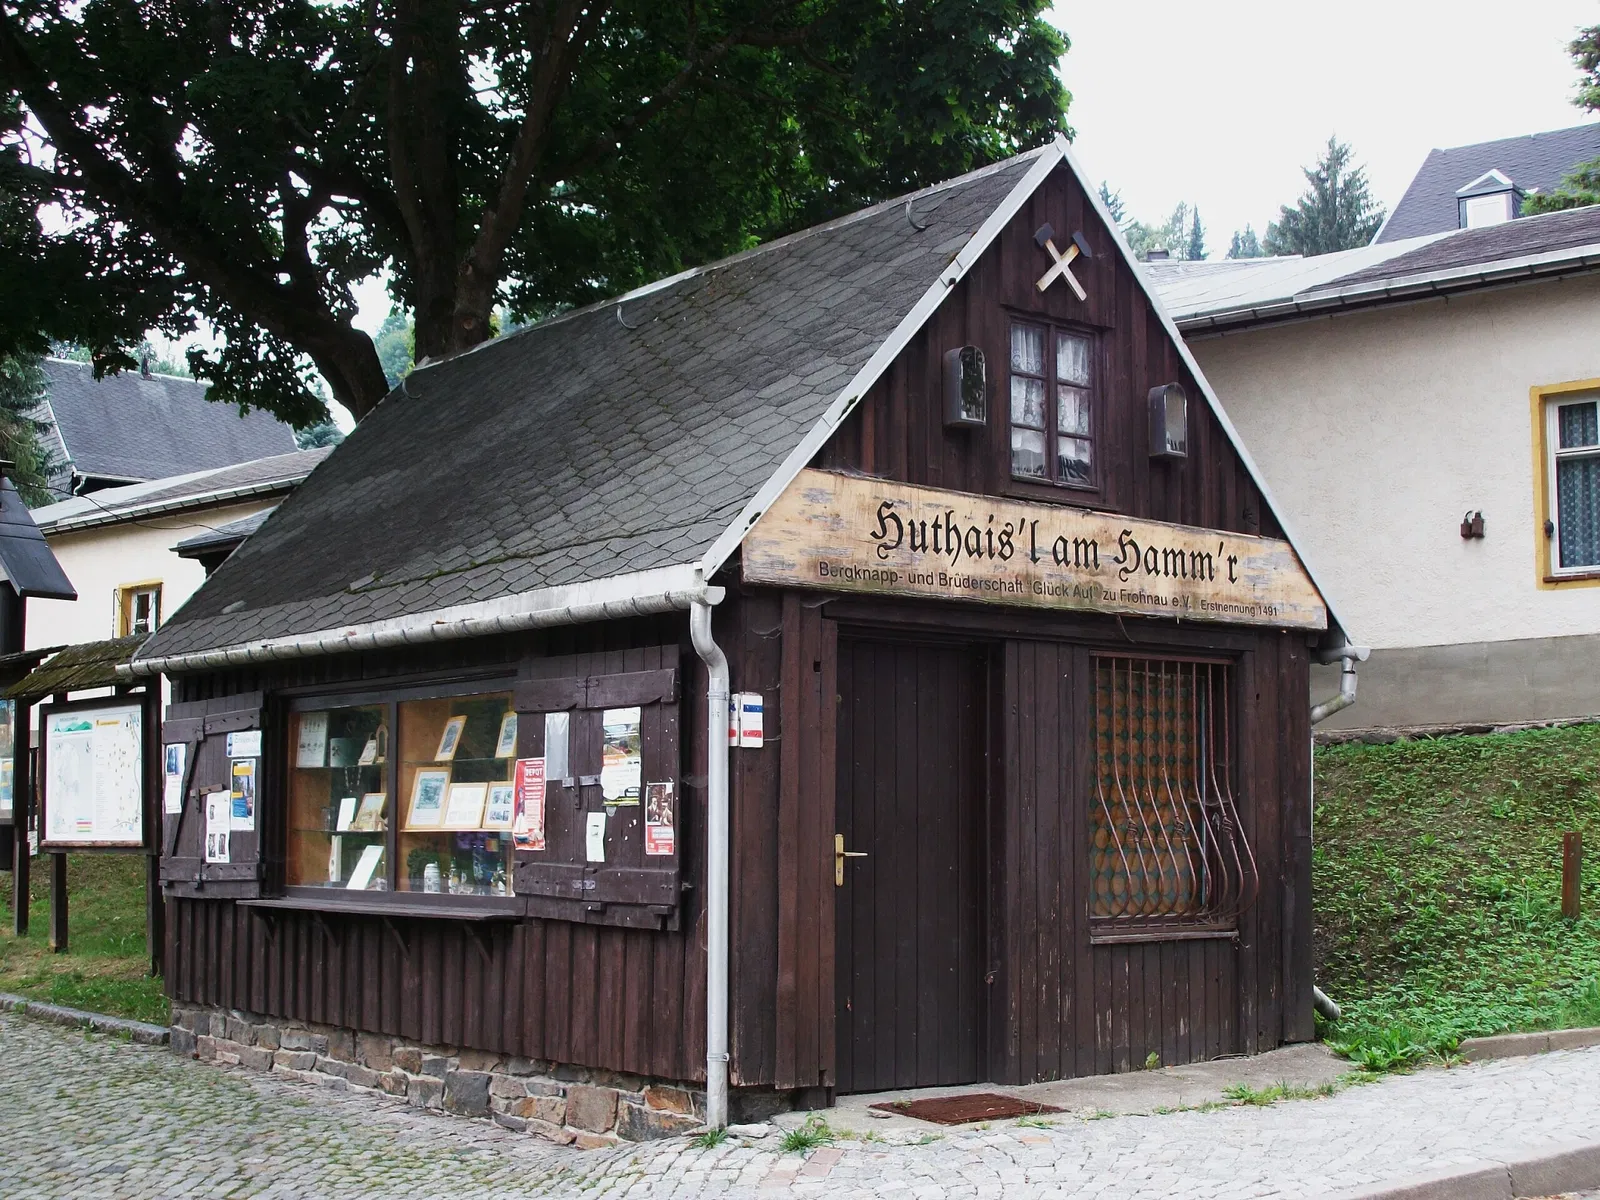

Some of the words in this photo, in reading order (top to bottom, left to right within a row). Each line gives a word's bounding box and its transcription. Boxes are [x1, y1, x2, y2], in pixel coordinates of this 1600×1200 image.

[870, 501, 1041, 567] Huthais'l
[1052, 535, 1101, 572] am
[1113, 529, 1238, 584] Hamm'r
[819, 561, 903, 586] Bergknapp-
[908, 572, 933, 586] und
[938, 572, 1024, 593] Brüderschaft
[1103, 589, 1117, 602] zu
[1120, 589, 1168, 606] Frohnau
[1172, 595, 1192, 609] e.V.
[1200, 599, 1255, 617] Erstnennung
[1258, 605, 1278, 617] 1491
